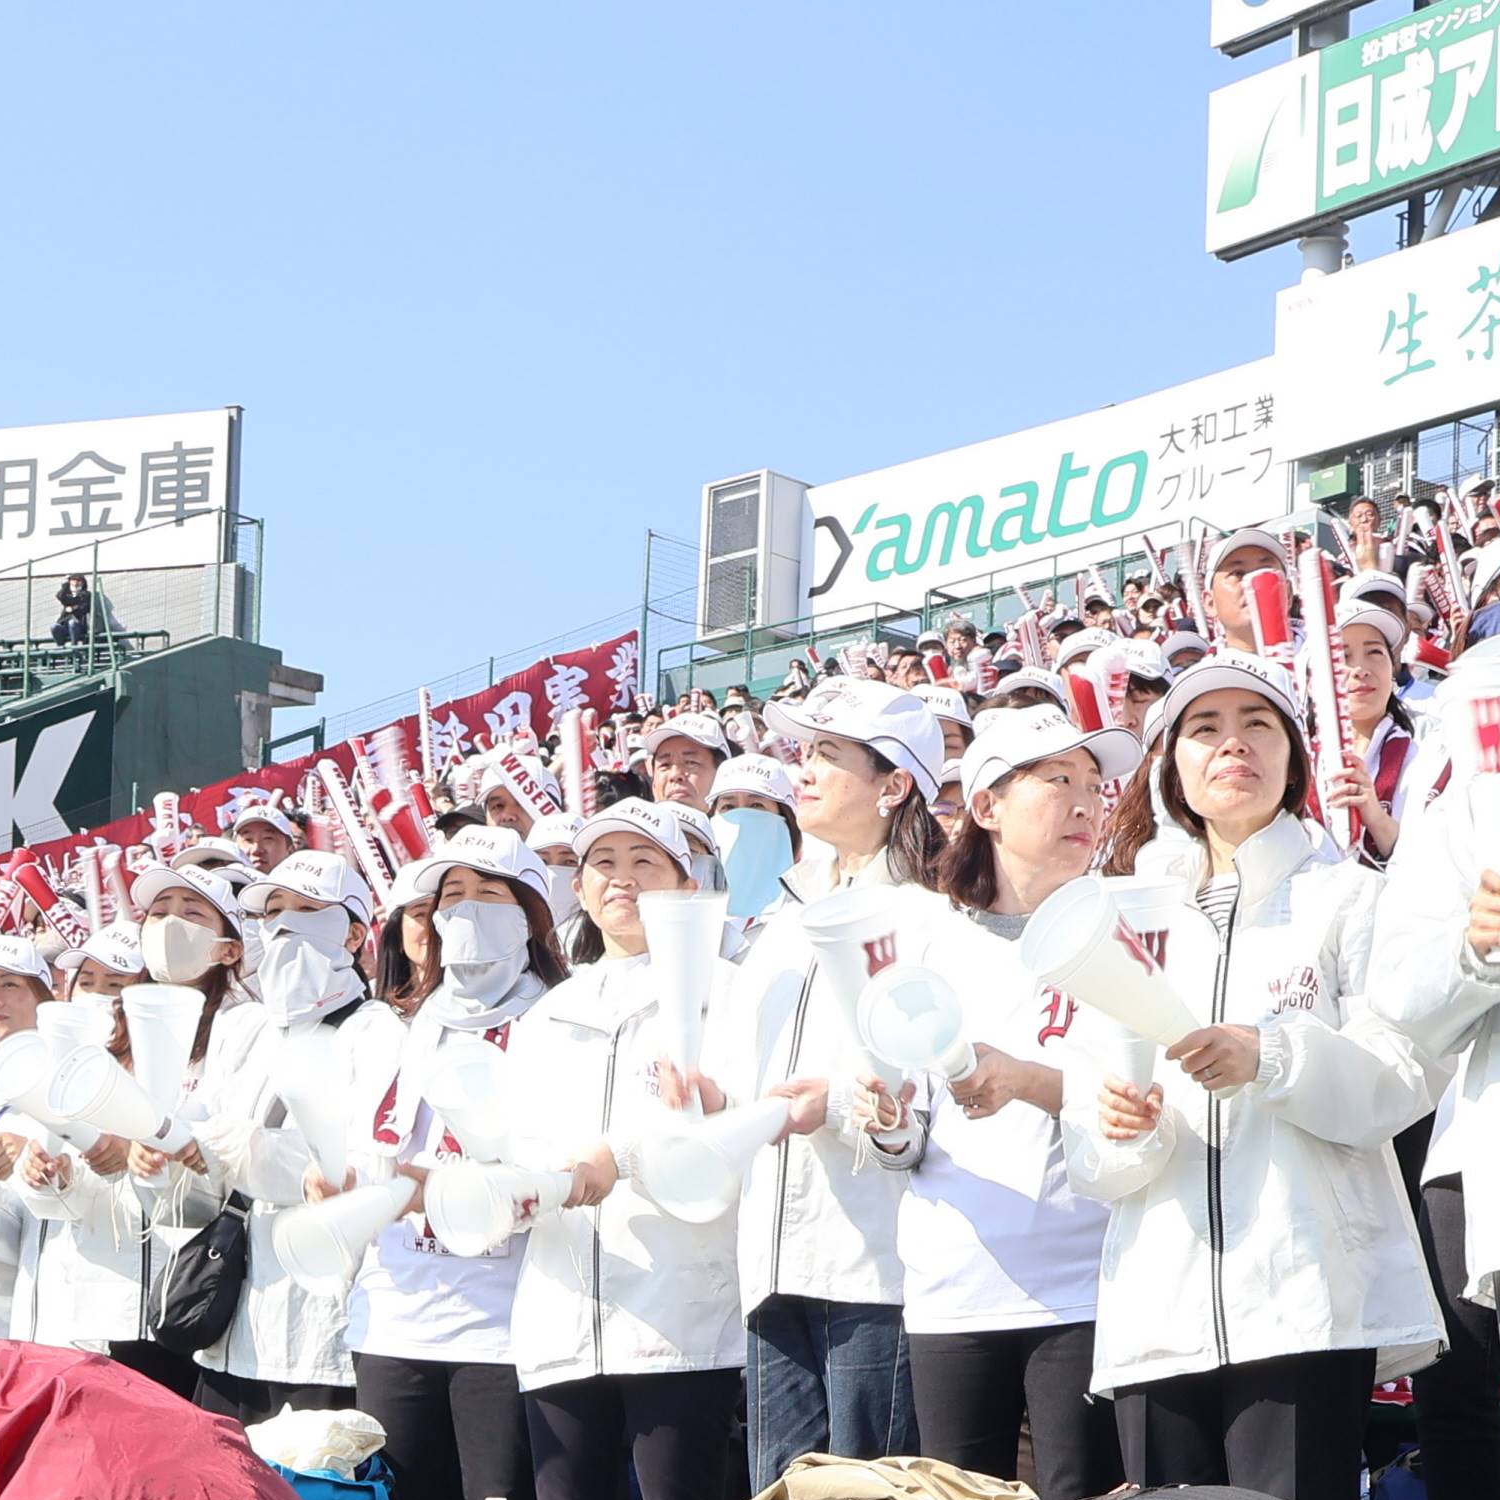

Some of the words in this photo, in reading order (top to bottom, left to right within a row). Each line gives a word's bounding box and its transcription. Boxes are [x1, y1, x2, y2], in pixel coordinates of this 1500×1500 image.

[1158, 393, 1274, 460] 大和工業
[808, 448, 1149, 598] Yamato
